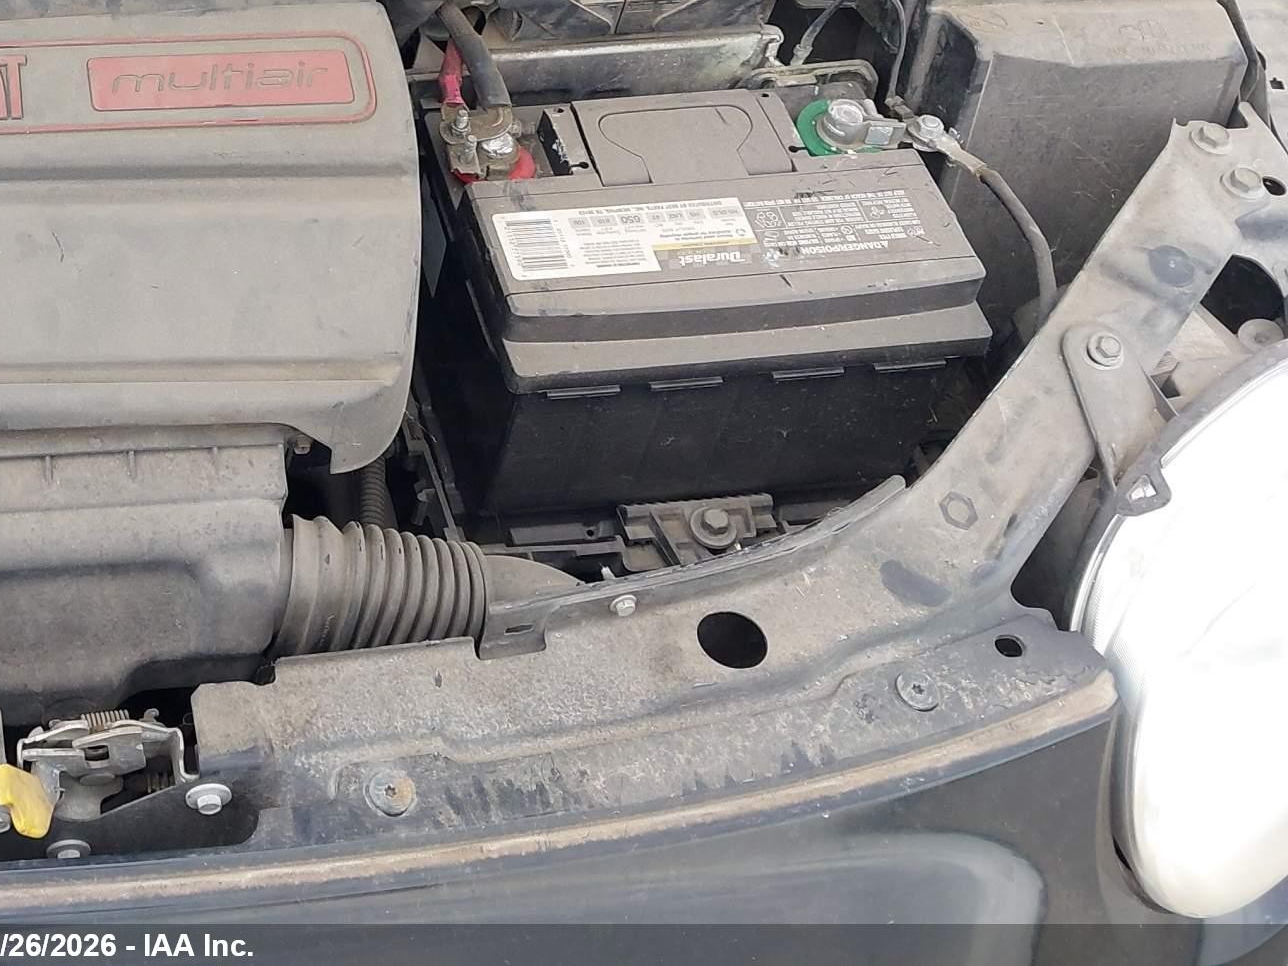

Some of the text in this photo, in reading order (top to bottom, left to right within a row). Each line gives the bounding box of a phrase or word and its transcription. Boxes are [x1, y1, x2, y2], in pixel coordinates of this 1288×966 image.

[112, 60, 328, 94] multiair
[800, 241, 881, 254] DANGER/POISON
[679, 250, 746, 267] Duralast
